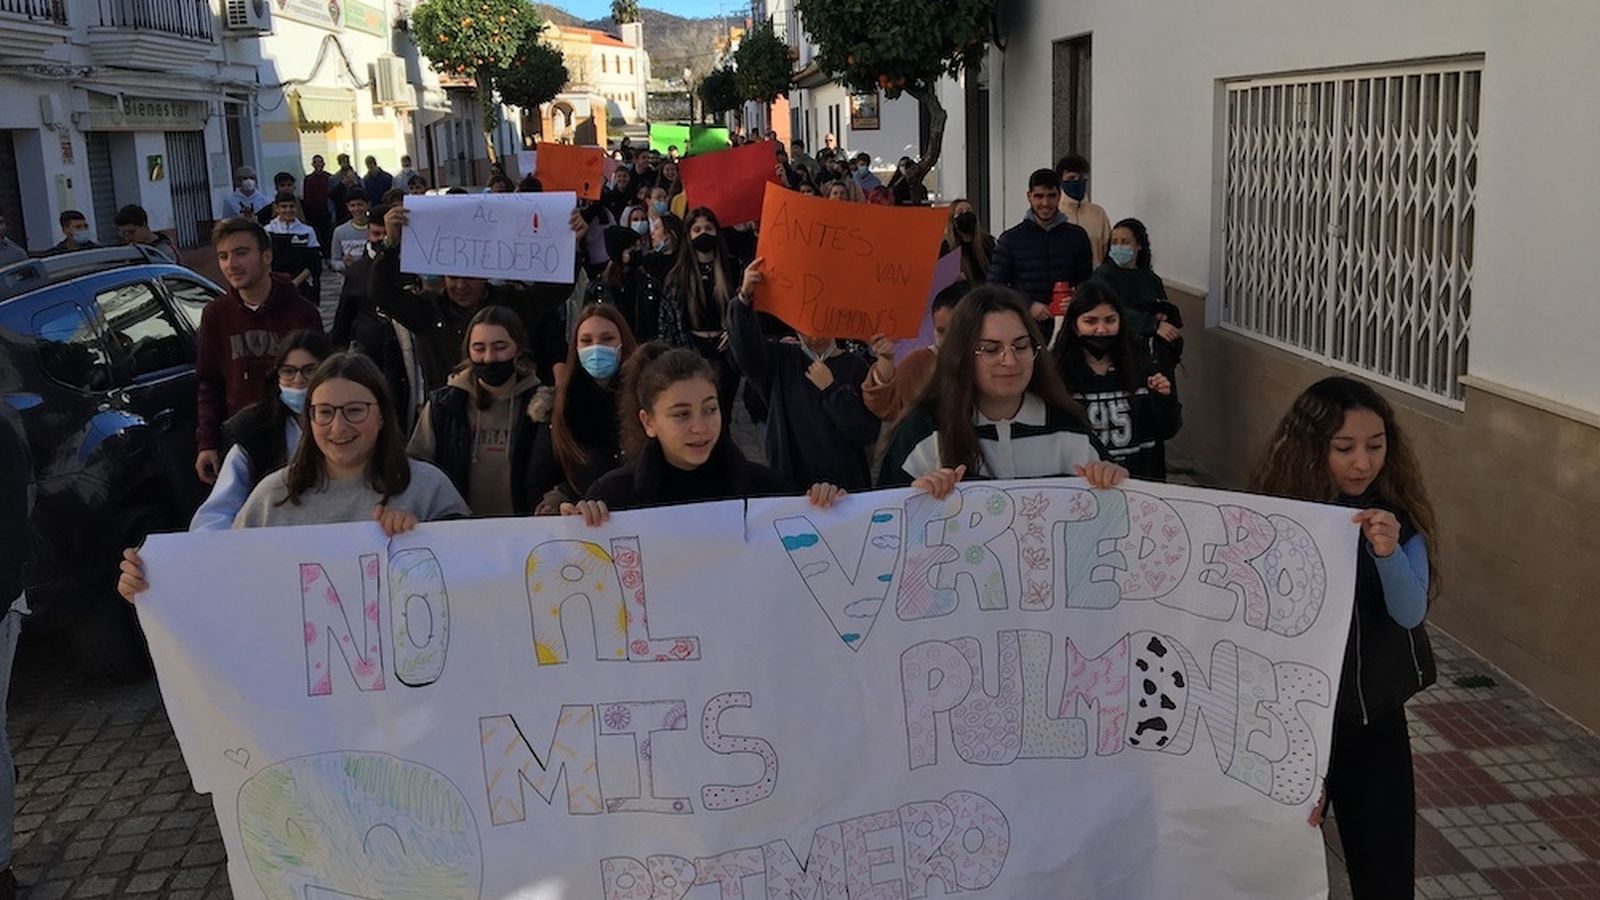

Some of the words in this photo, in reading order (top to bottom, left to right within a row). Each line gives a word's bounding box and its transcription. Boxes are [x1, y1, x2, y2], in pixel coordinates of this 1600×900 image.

[124, 101, 190, 118] Bienestar
[472, 205, 499, 224] AL
[769, 201, 874, 257] ANTES
[409, 225, 560, 274] VERTEDERO
[877, 261, 913, 286] VAN
[1087, 399, 1132, 448] 95
[299, 547, 450, 697] NO
[525, 535, 701, 666] AL
[773, 486, 1328, 653] VERTEDERO
[478, 691, 779, 827] MIS
[901, 629, 1331, 806] PULMONES
